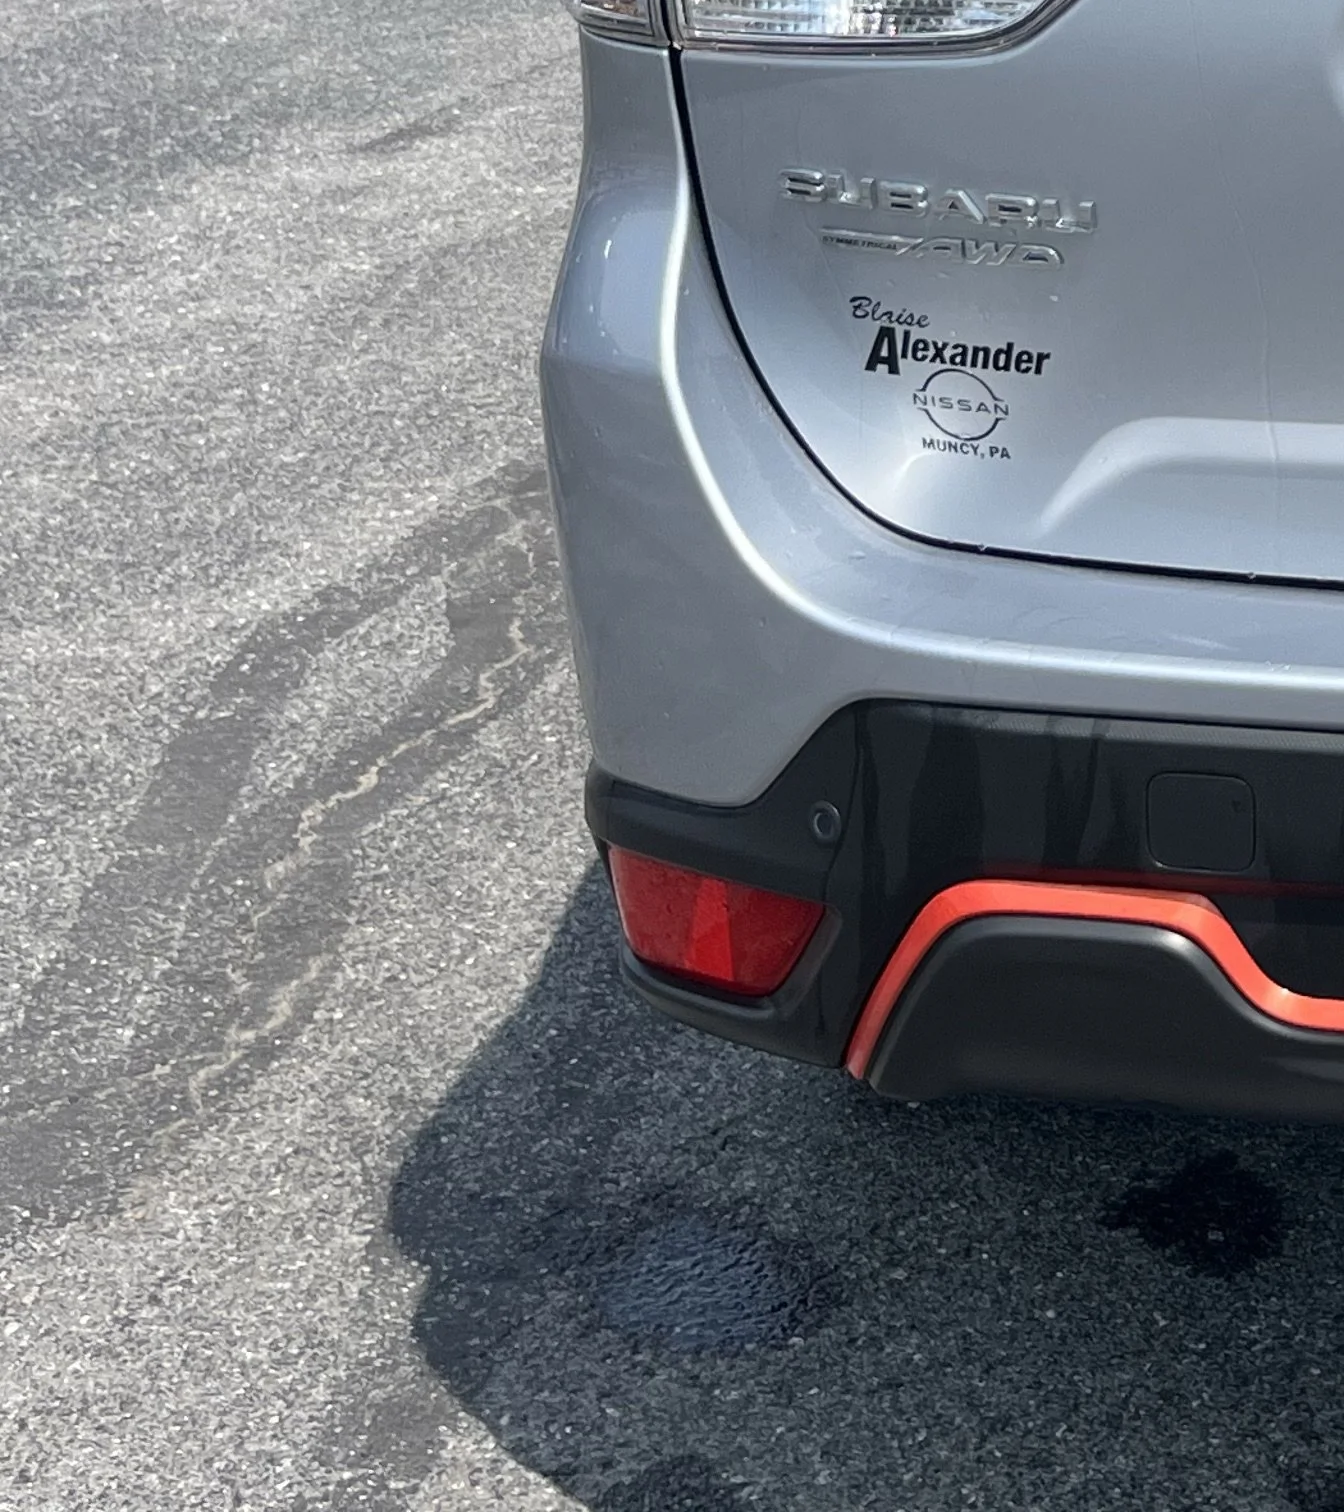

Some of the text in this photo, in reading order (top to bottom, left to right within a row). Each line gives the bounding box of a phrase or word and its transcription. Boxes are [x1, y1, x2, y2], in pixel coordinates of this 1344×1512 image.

[779, 167, 1098, 234] SUBARU
[900, 236, 1065, 267] AWD
[850, 295, 930, 329] Blaise
[864, 326, 1052, 376] Alexander
[912, 392, 1009, 417] NISSAN
[921, 437, 1012, 460] MUNCY, PA
